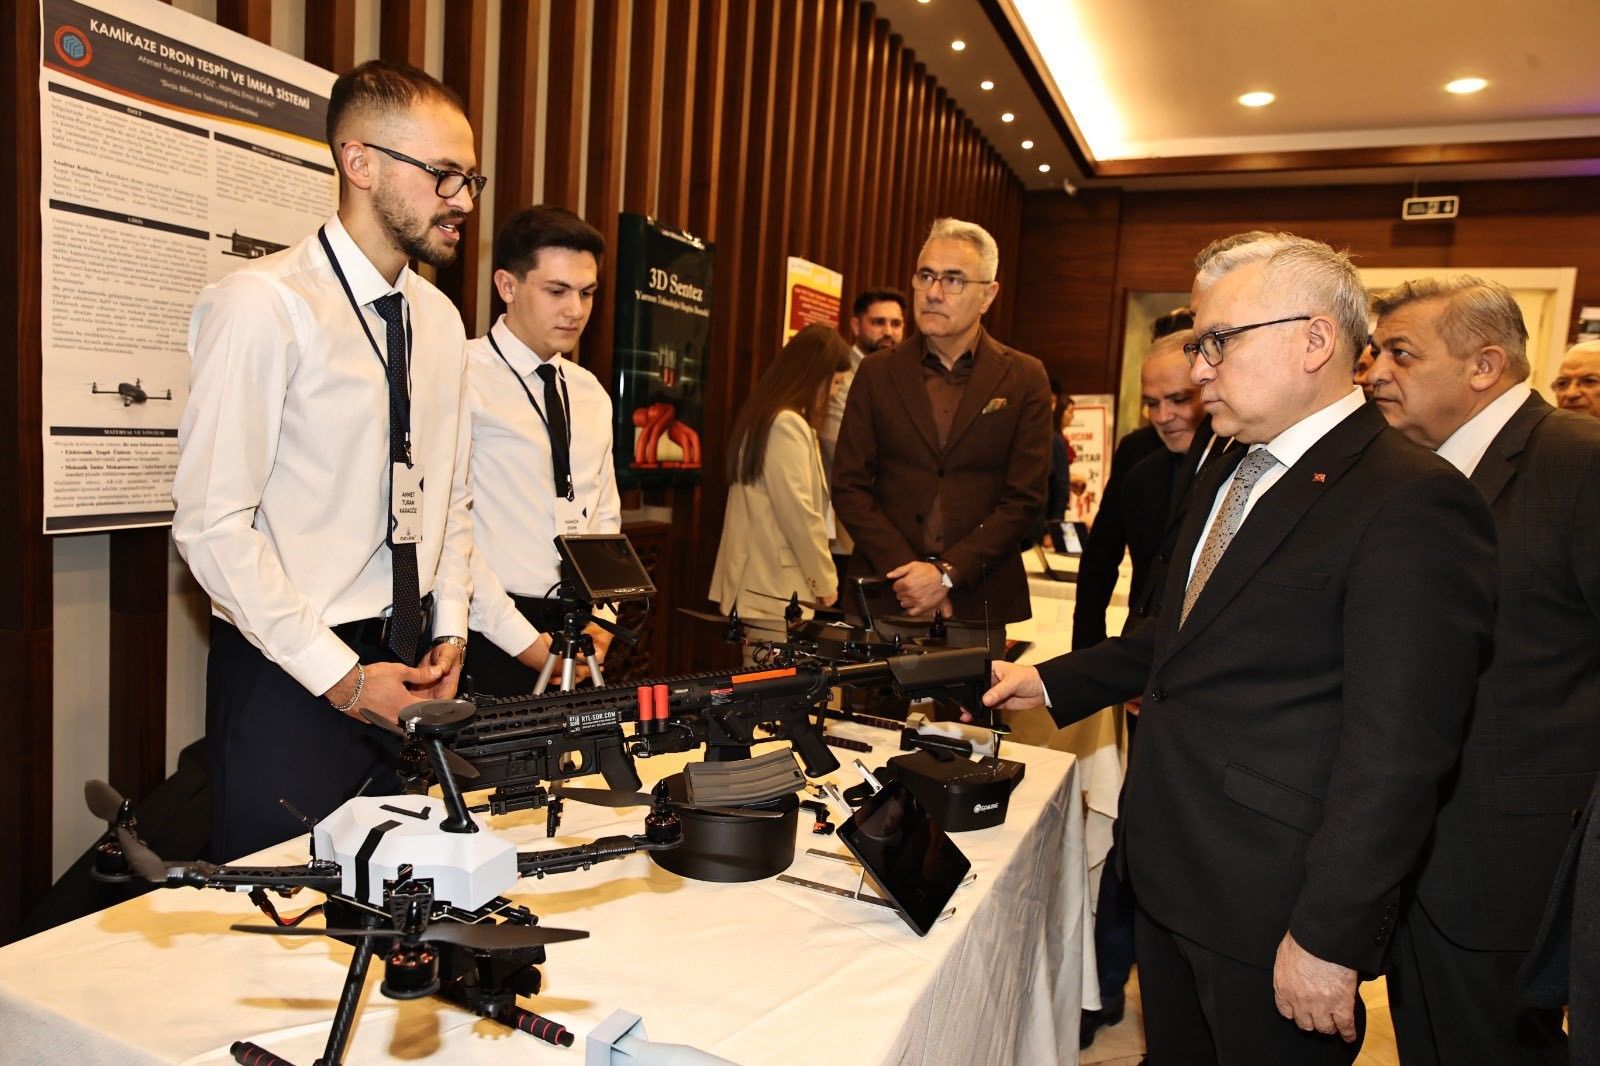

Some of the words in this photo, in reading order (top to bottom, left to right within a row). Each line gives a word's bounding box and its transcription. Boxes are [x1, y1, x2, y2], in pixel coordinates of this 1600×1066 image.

[90, 18, 157, 53] KAMİKAZE
[160, 44, 195, 67] DRON
[197, 58, 230, 80] TESPİT
[230, 70, 246, 86] VE
[247, 74, 274, 97] İMHA
[276, 87, 310, 110] SİSTEMİ
[649, 267, 668, 291] 3D
[582, 711, 616, 722] RTL-SDR.COM
